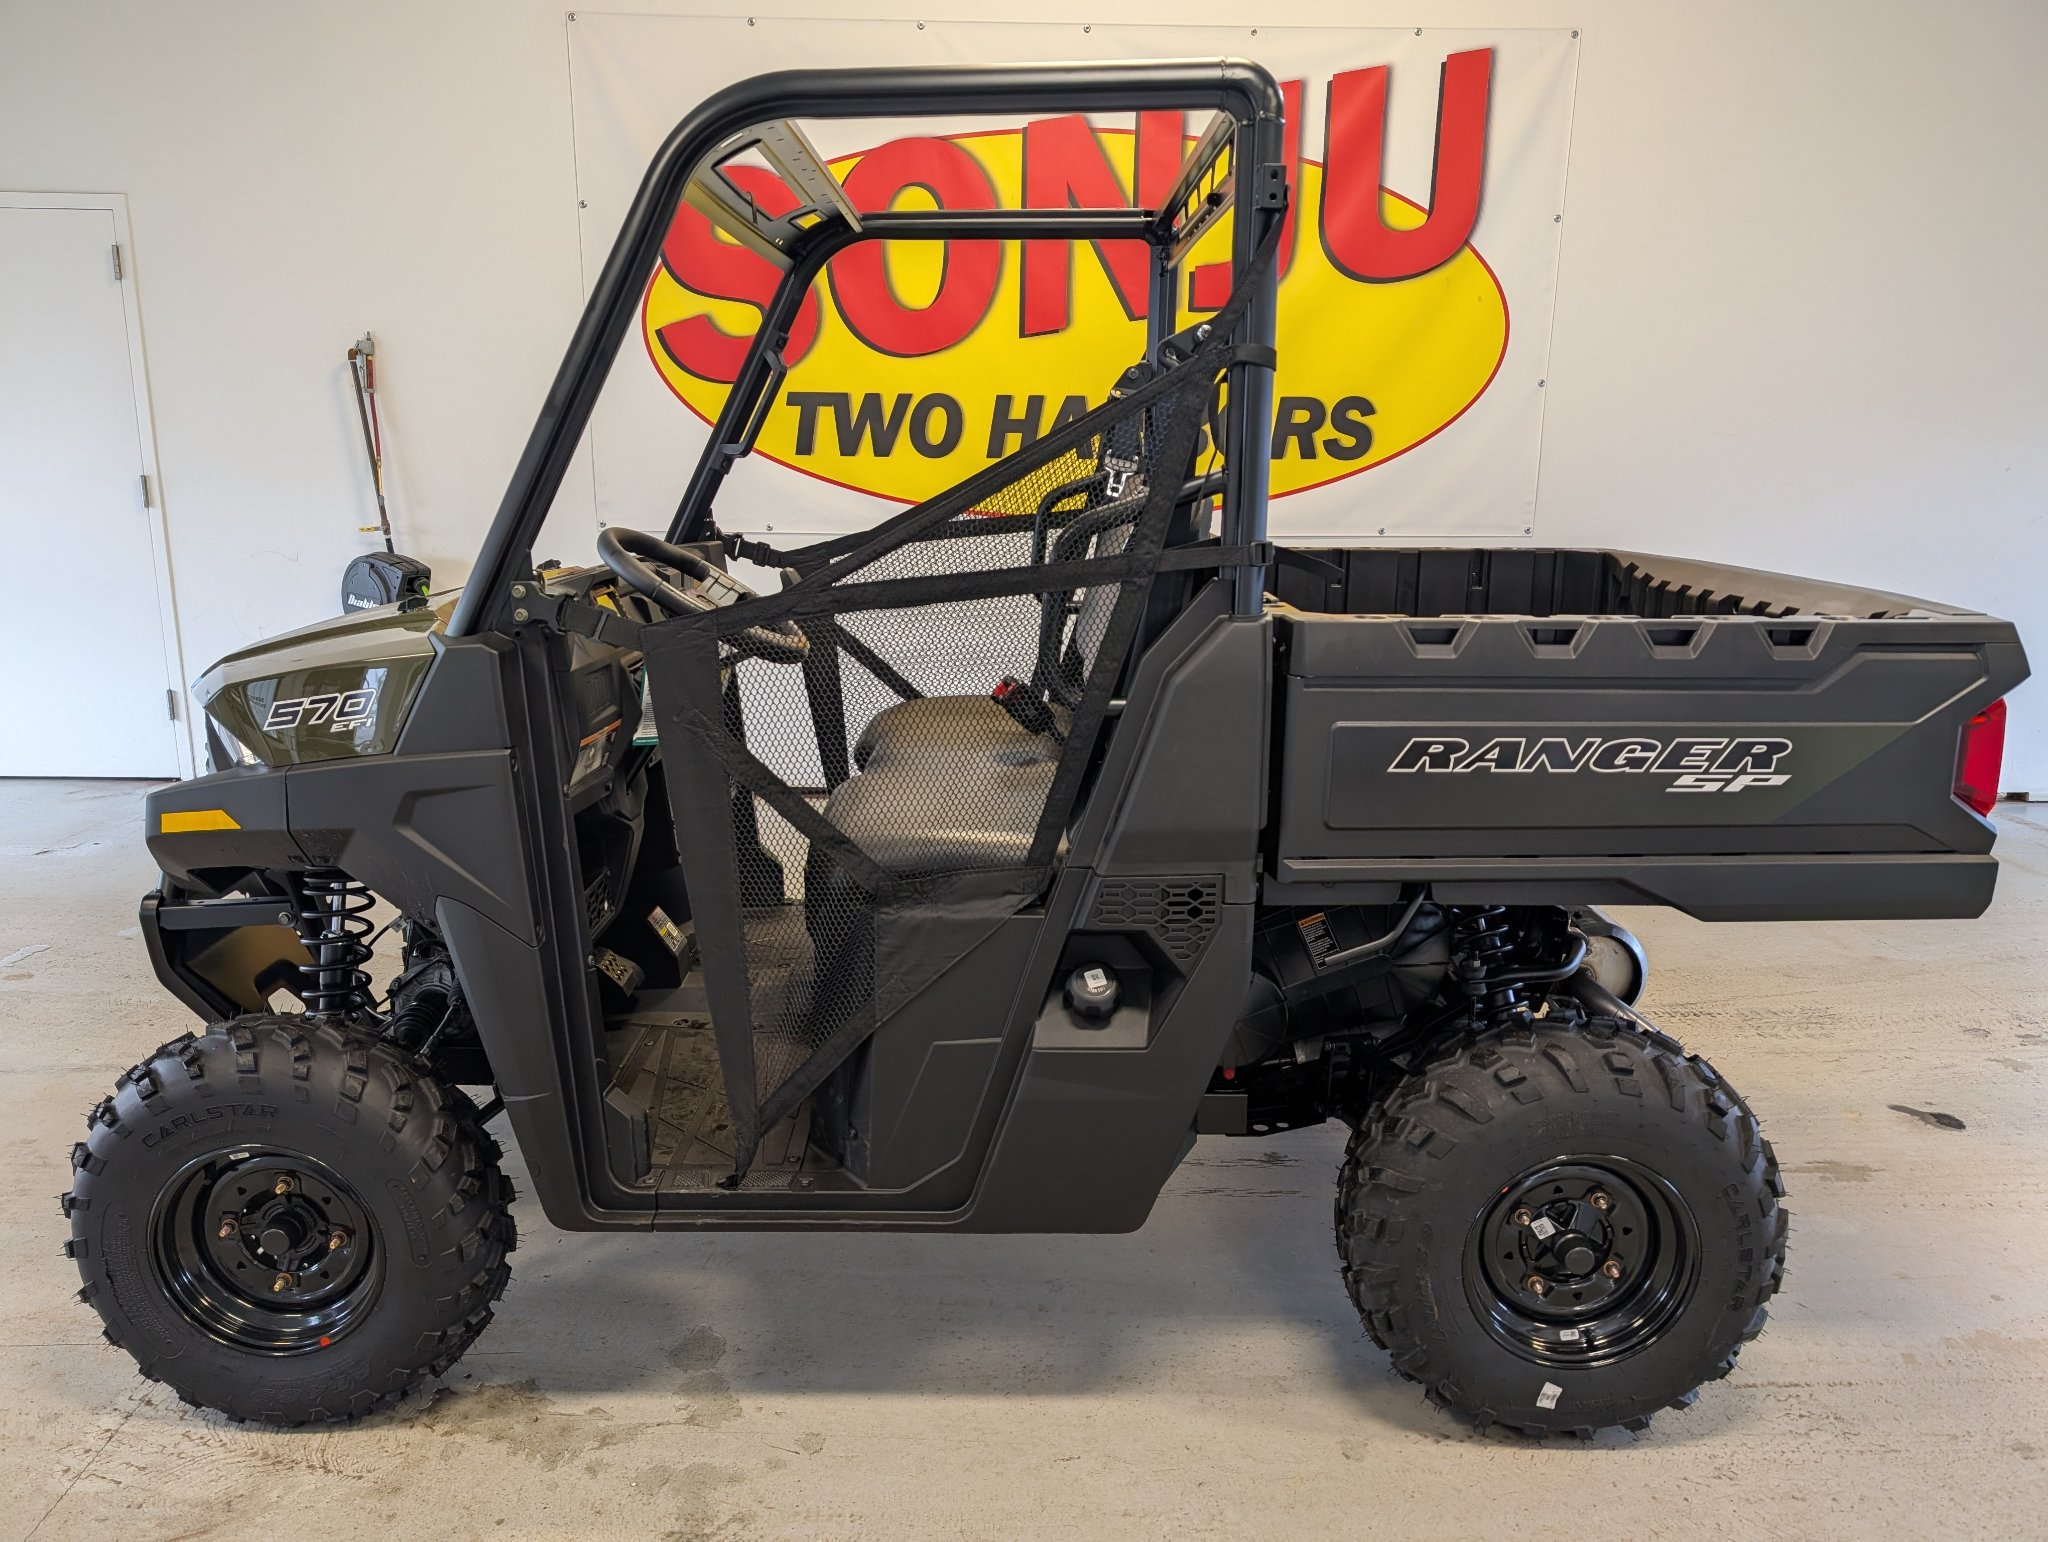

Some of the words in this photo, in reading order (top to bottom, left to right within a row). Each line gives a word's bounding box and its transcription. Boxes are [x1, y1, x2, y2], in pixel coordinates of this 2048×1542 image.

[786, 393, 964, 460] TWO
[262, 688, 377, 731] 570
[329, 717, 373, 733] EFI
[1386, 737, 1793, 773] RANGER
[1664, 774, 1793, 793] SP
[141, 1102, 280, 1149] CARLSTAR
[1721, 1183, 1754, 1312] CARLSTAR
